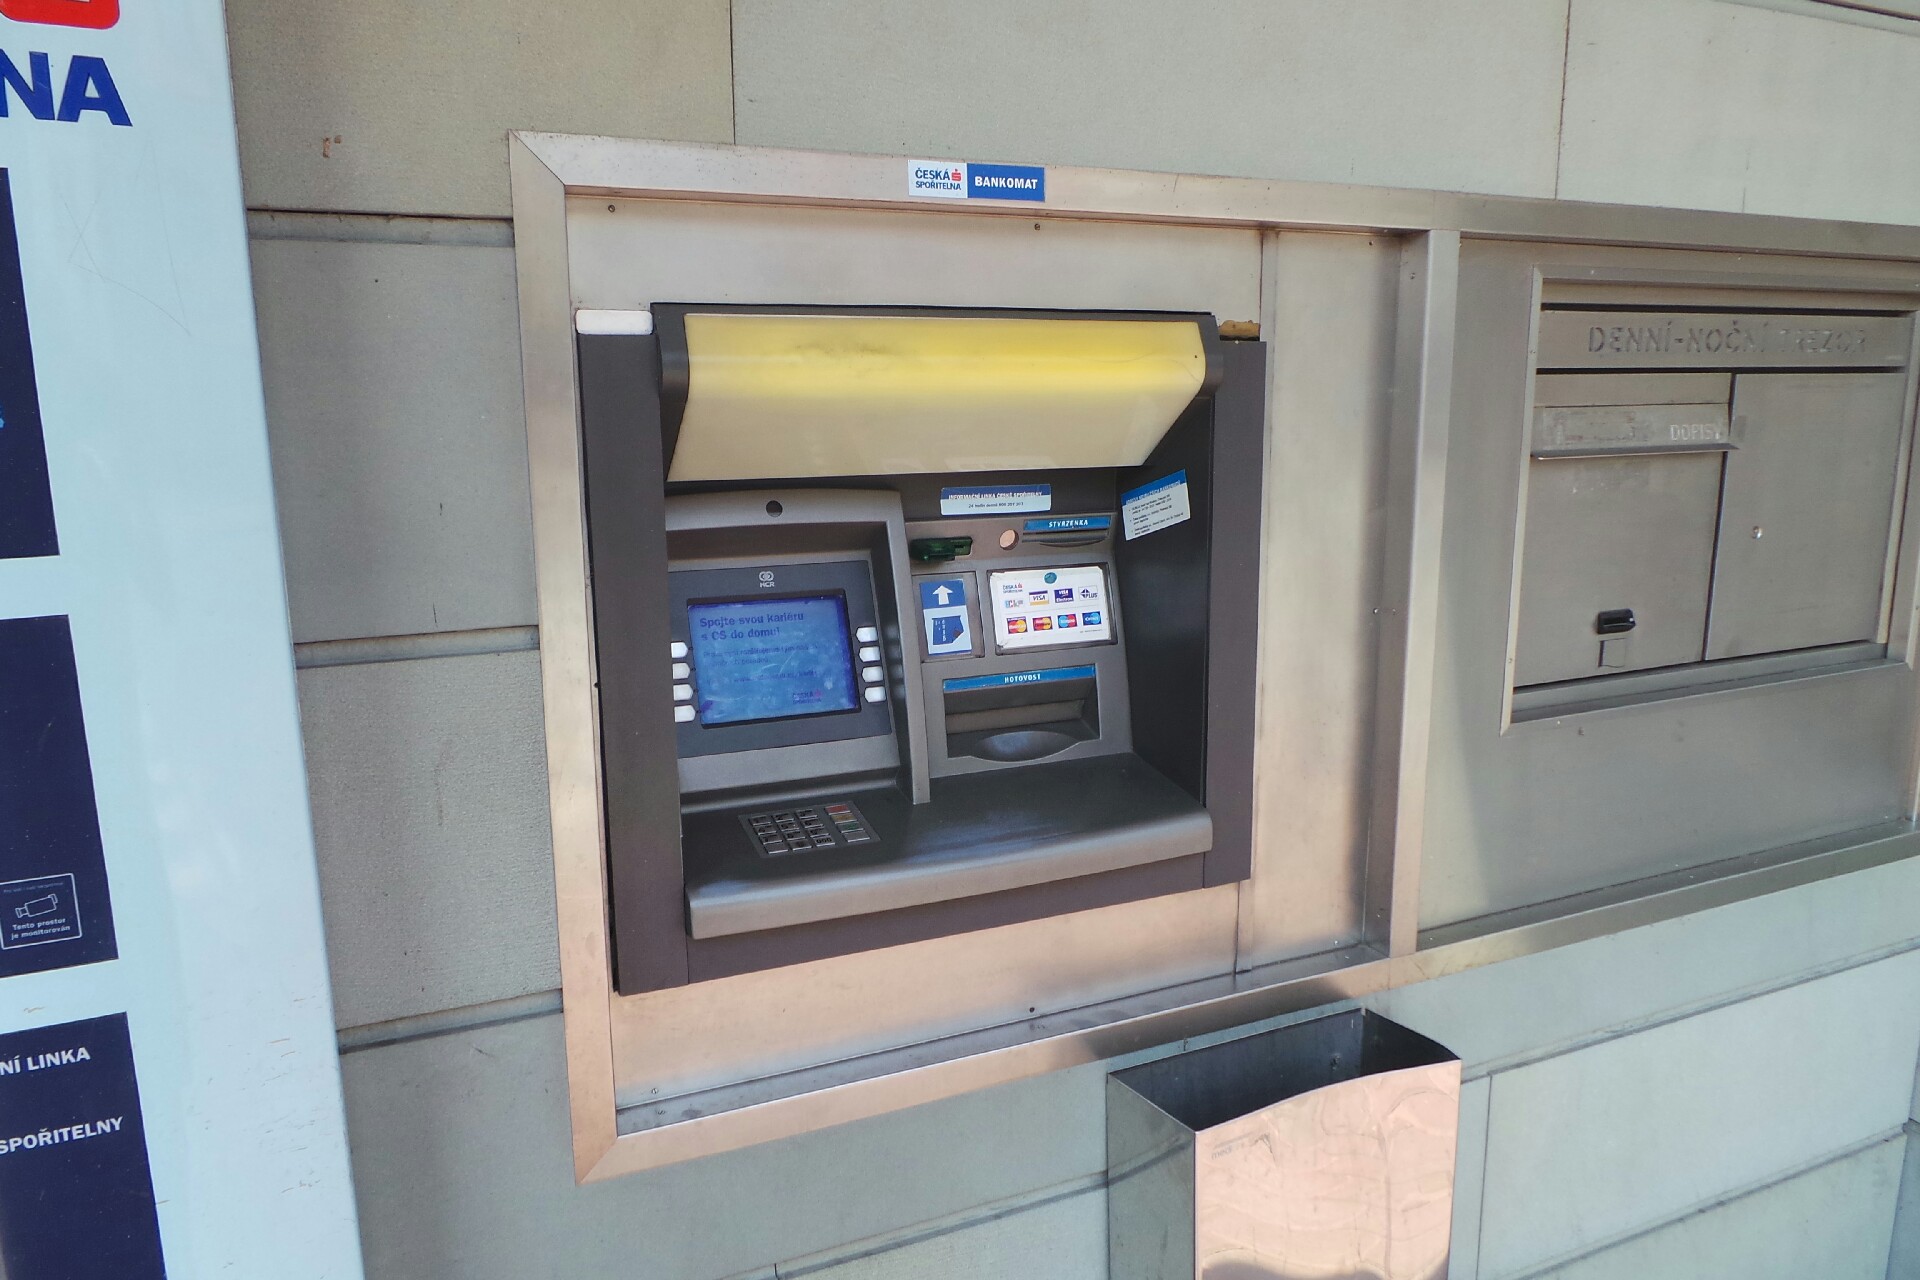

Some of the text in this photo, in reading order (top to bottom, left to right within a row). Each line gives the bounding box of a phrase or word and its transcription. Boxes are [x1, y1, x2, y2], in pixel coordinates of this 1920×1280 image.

[0, 48, 133, 127] NA
[915, 167, 950, 181] ČESKÁ
[915, 180, 962, 191] SPOŘITELNA
[974, 176, 1038, 190] BANKOMAT
[1048, 519, 1089, 528] STVRZENKA
[700, 612, 804, 628] Spojte svou kariéru
[731, 629, 744, 639] do
[1004, 673, 1041, 684] HOTOVOST
[12, 918, 66, 931] Tento prostor
[11, 932, 18, 940] je
[0, 1046, 91, 1076] NÍ LINKA
[0, 1116, 124, 1154] SPOŘITELNY
